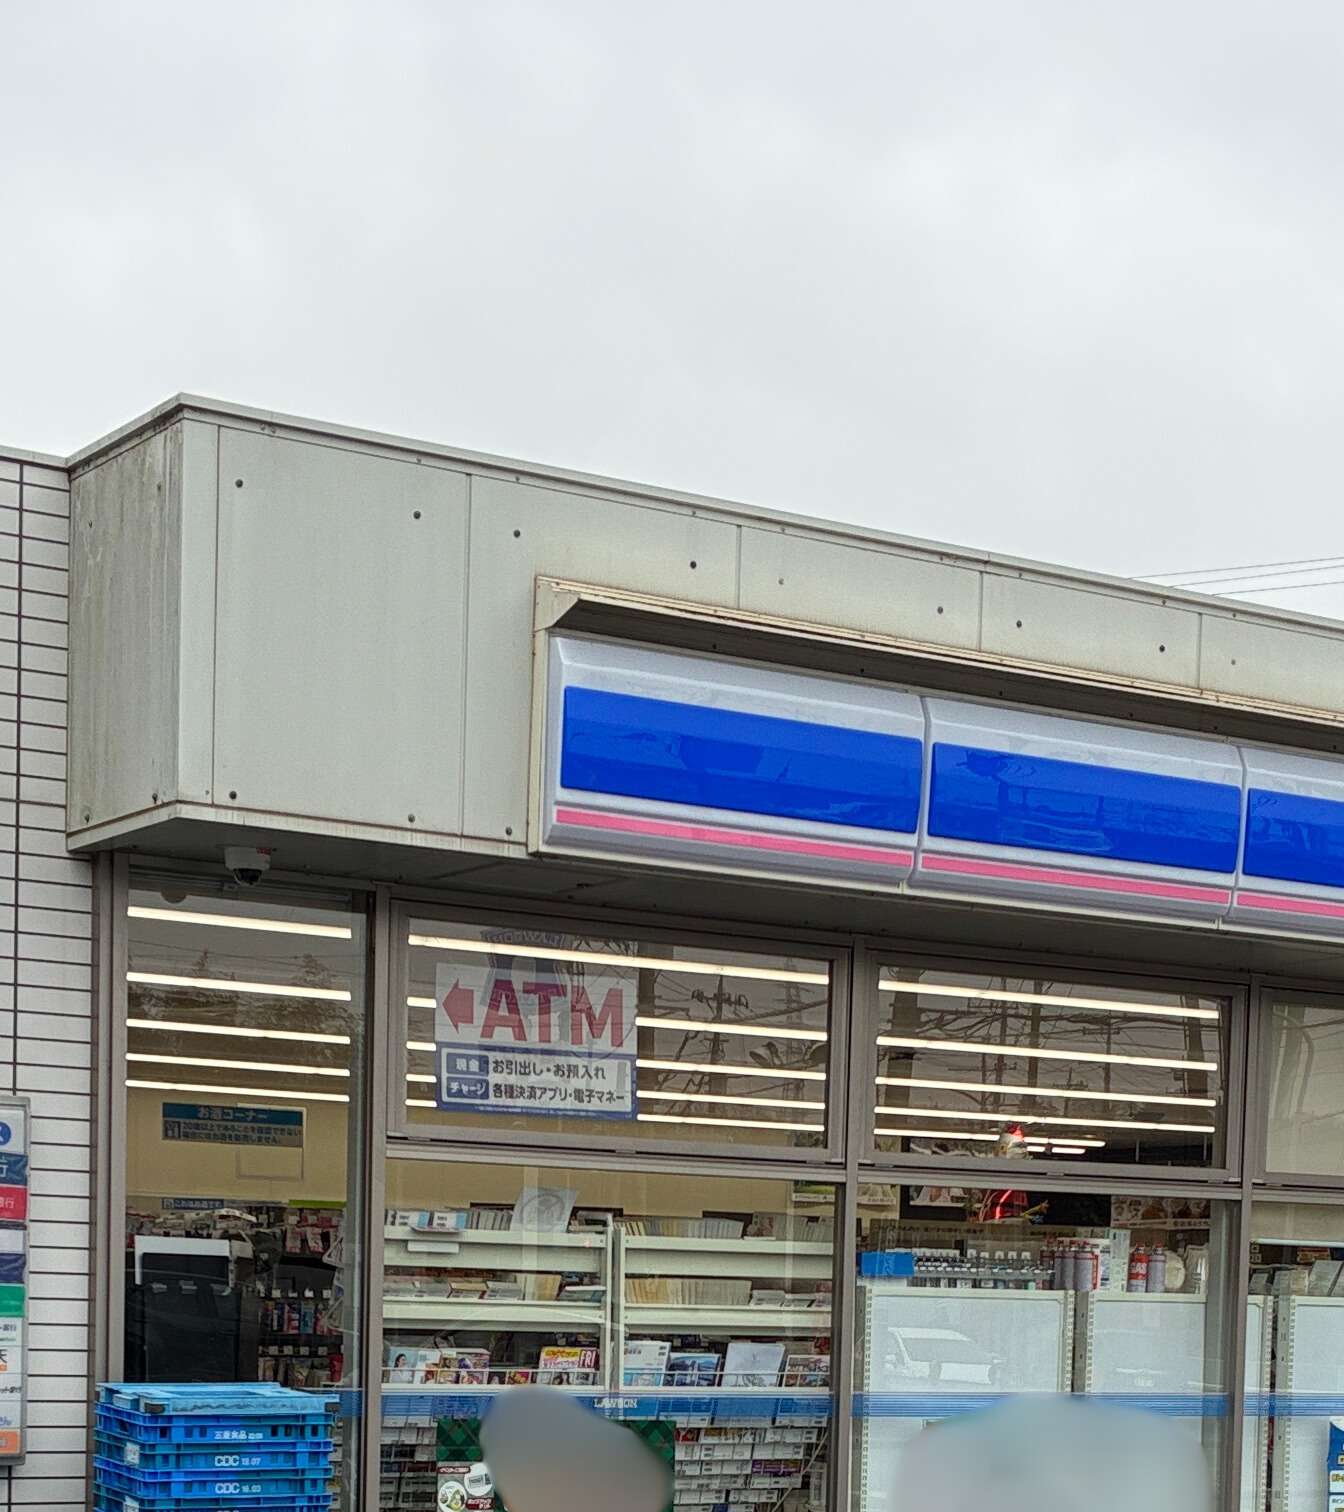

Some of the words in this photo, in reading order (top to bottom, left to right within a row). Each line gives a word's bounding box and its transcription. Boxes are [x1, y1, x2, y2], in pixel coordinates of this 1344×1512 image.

[480, 979, 623, 1048] ATM
[449, 1081, 485, 1096] チャージ
[215, 1455, 240, 1467] CDC
[215, 1482, 240, 1494] CDC
